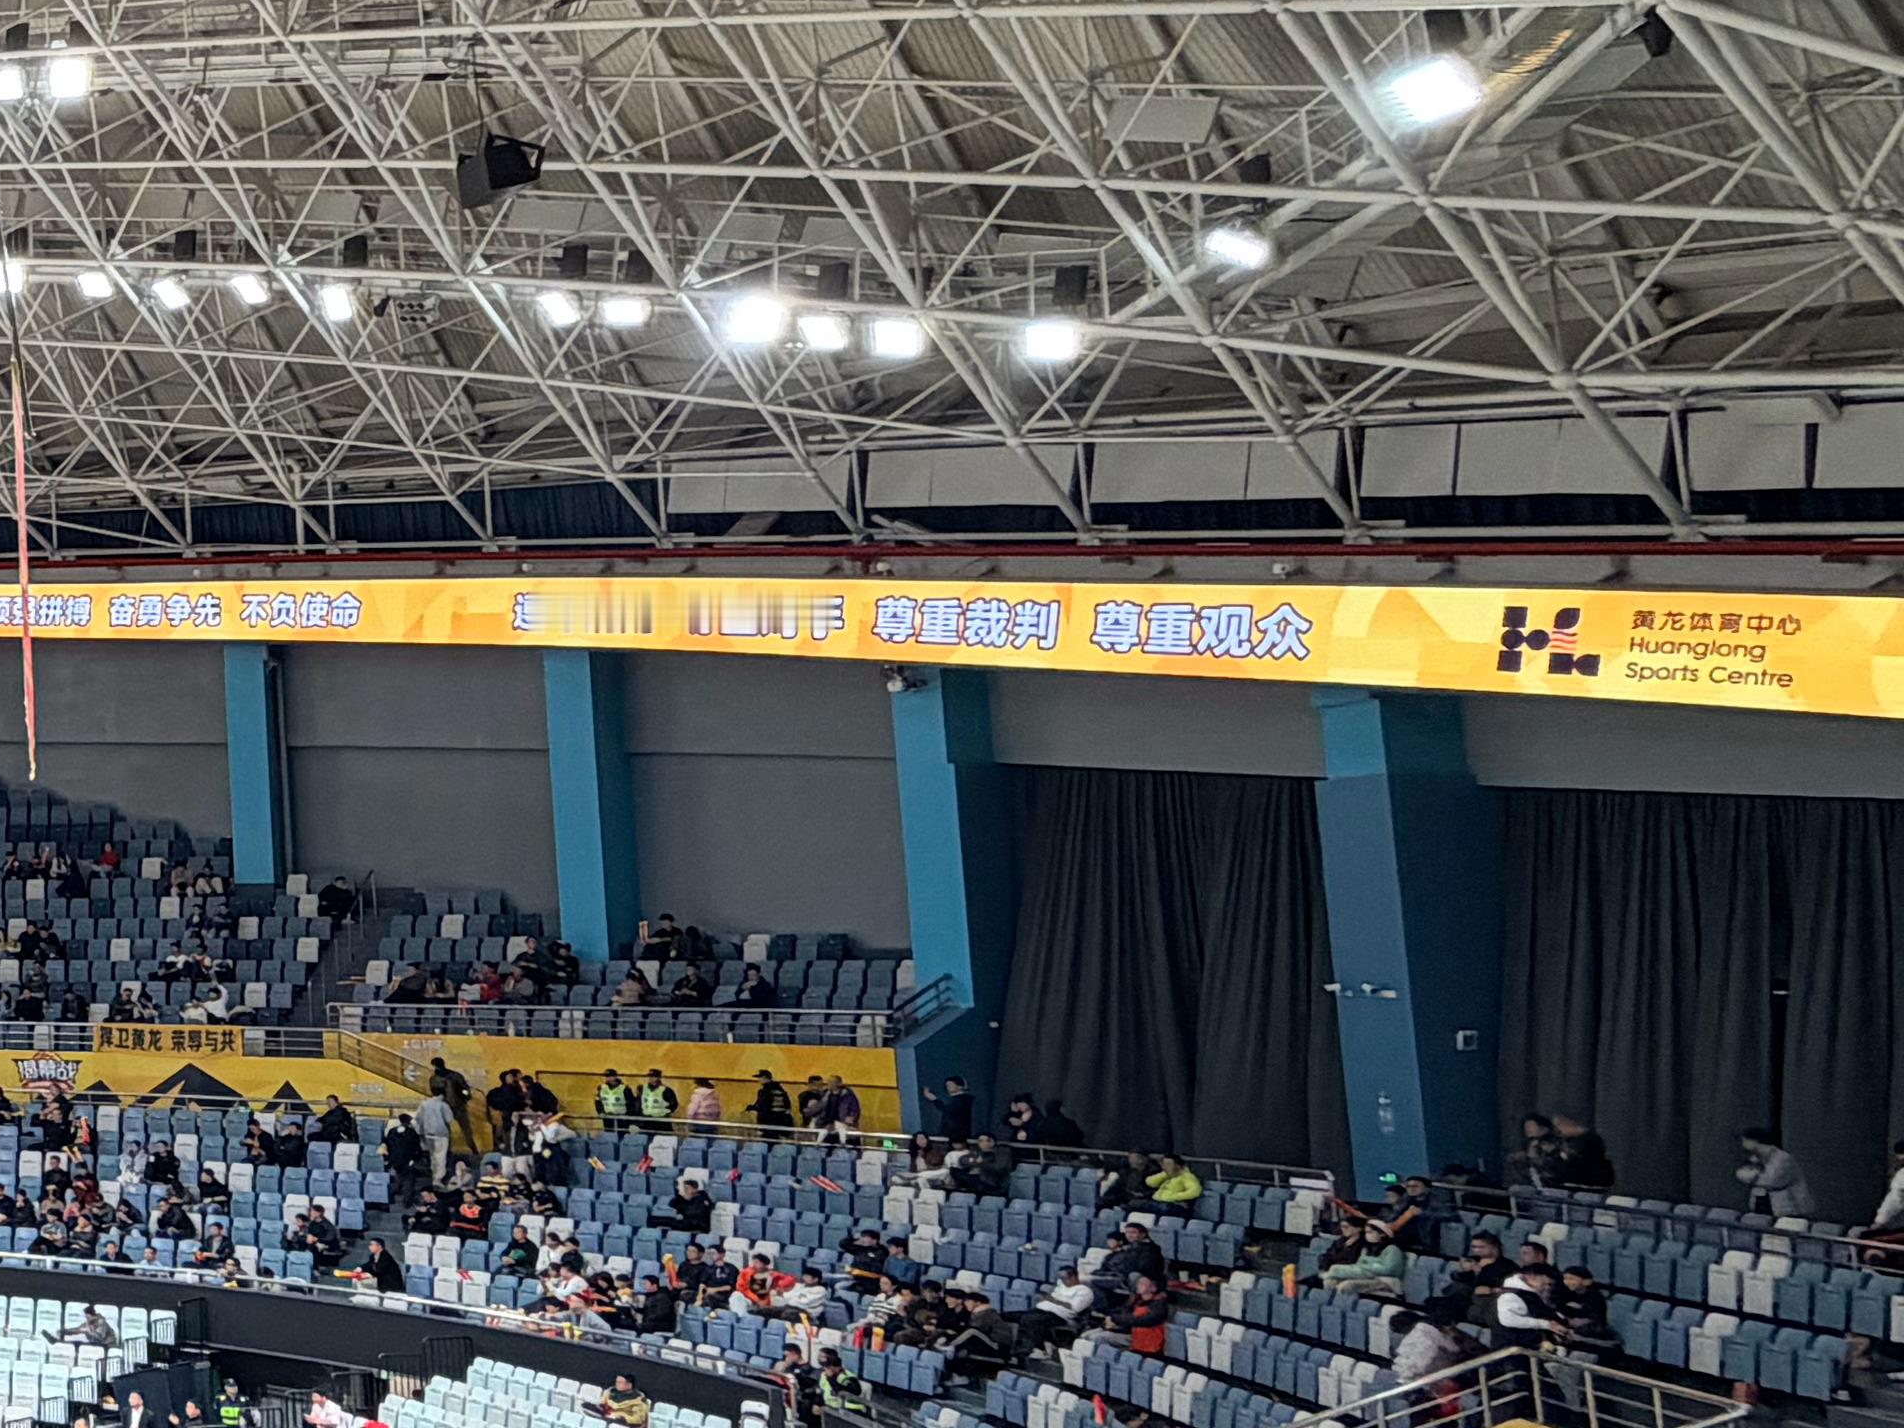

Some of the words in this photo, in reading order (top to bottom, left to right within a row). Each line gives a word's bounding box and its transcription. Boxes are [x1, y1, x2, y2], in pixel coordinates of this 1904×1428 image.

[107, 594, 223, 628] 奋勇争先
[240, 592, 362, 629] 不负使命
[1632, 609, 1803, 636] 黄龙体育中心
[872, 594, 1061, 650] 尊重裁判
[1091, 599, 1313, 660] 尊重观众
[1629, 636, 1766, 662] Huanglong
[1625, 662, 1699, 686] Sports
[1709, 666, 1794, 689] Centre
[100, 1026, 162, 1050] 捍卫黄龙
